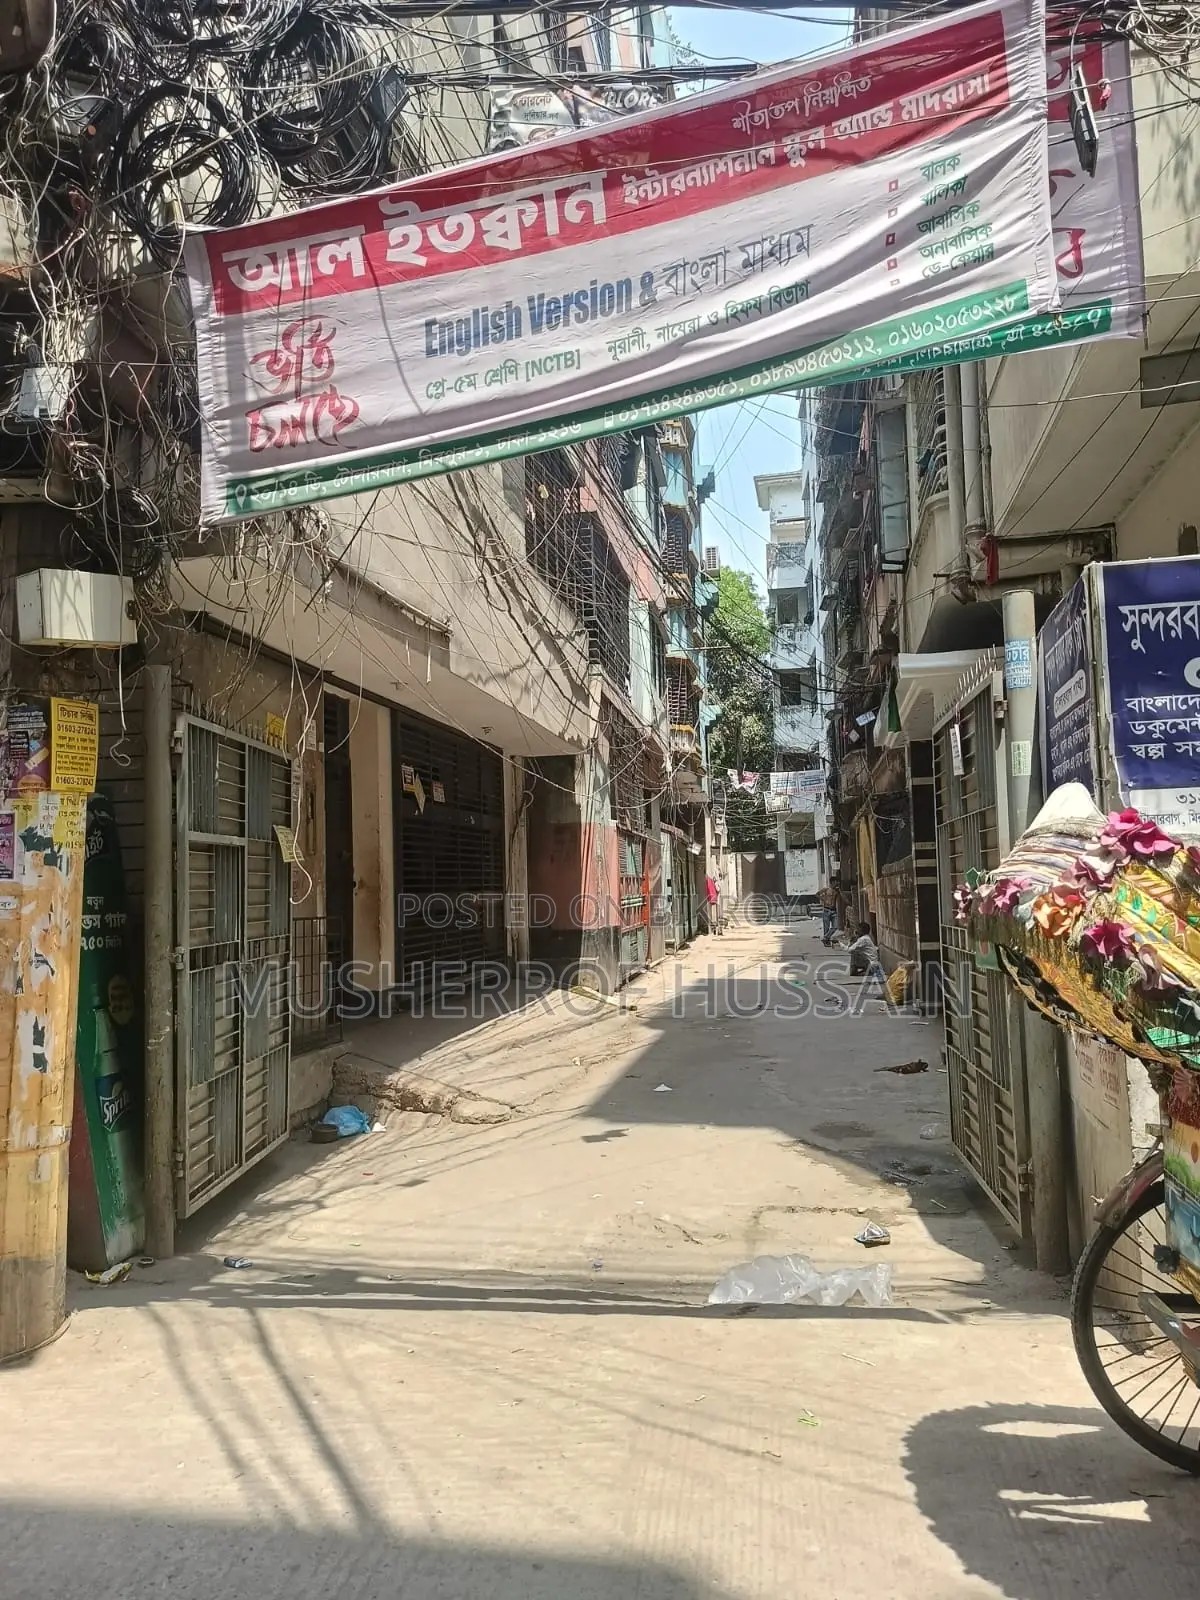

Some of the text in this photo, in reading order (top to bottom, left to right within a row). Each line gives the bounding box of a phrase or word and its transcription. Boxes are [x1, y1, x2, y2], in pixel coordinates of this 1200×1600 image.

[731, 101, 800, 135] শীতাতপ
[221, 224, 366, 291] আল
[621, 140, 776, 205] ইন্টারন্যাশনাল
[782, 125, 826, 168] স্কুল
[832, 102, 895, 140] অ্যান্ড
[899, 66, 992, 121] মাদরাসা
[920, 153, 961, 181] বালক
[920, 174, 968, 206] বালিকা
[916, 200, 980, 234] আবাসিক
[919, 223, 992, 259] অনাবাসিক
[424, 224, 814, 359] English Version & বাংলা মাধ্যম
[485, 359, 520, 386] শ্রেণি
[525, 349, 580, 382] [NCTB]
[606, 326, 651, 361] নূরানী,
[707, 311, 719, 325] ও
[767, 279, 811, 313] বিভাগ
[1128, 742, 1168, 760] স্বল্প
